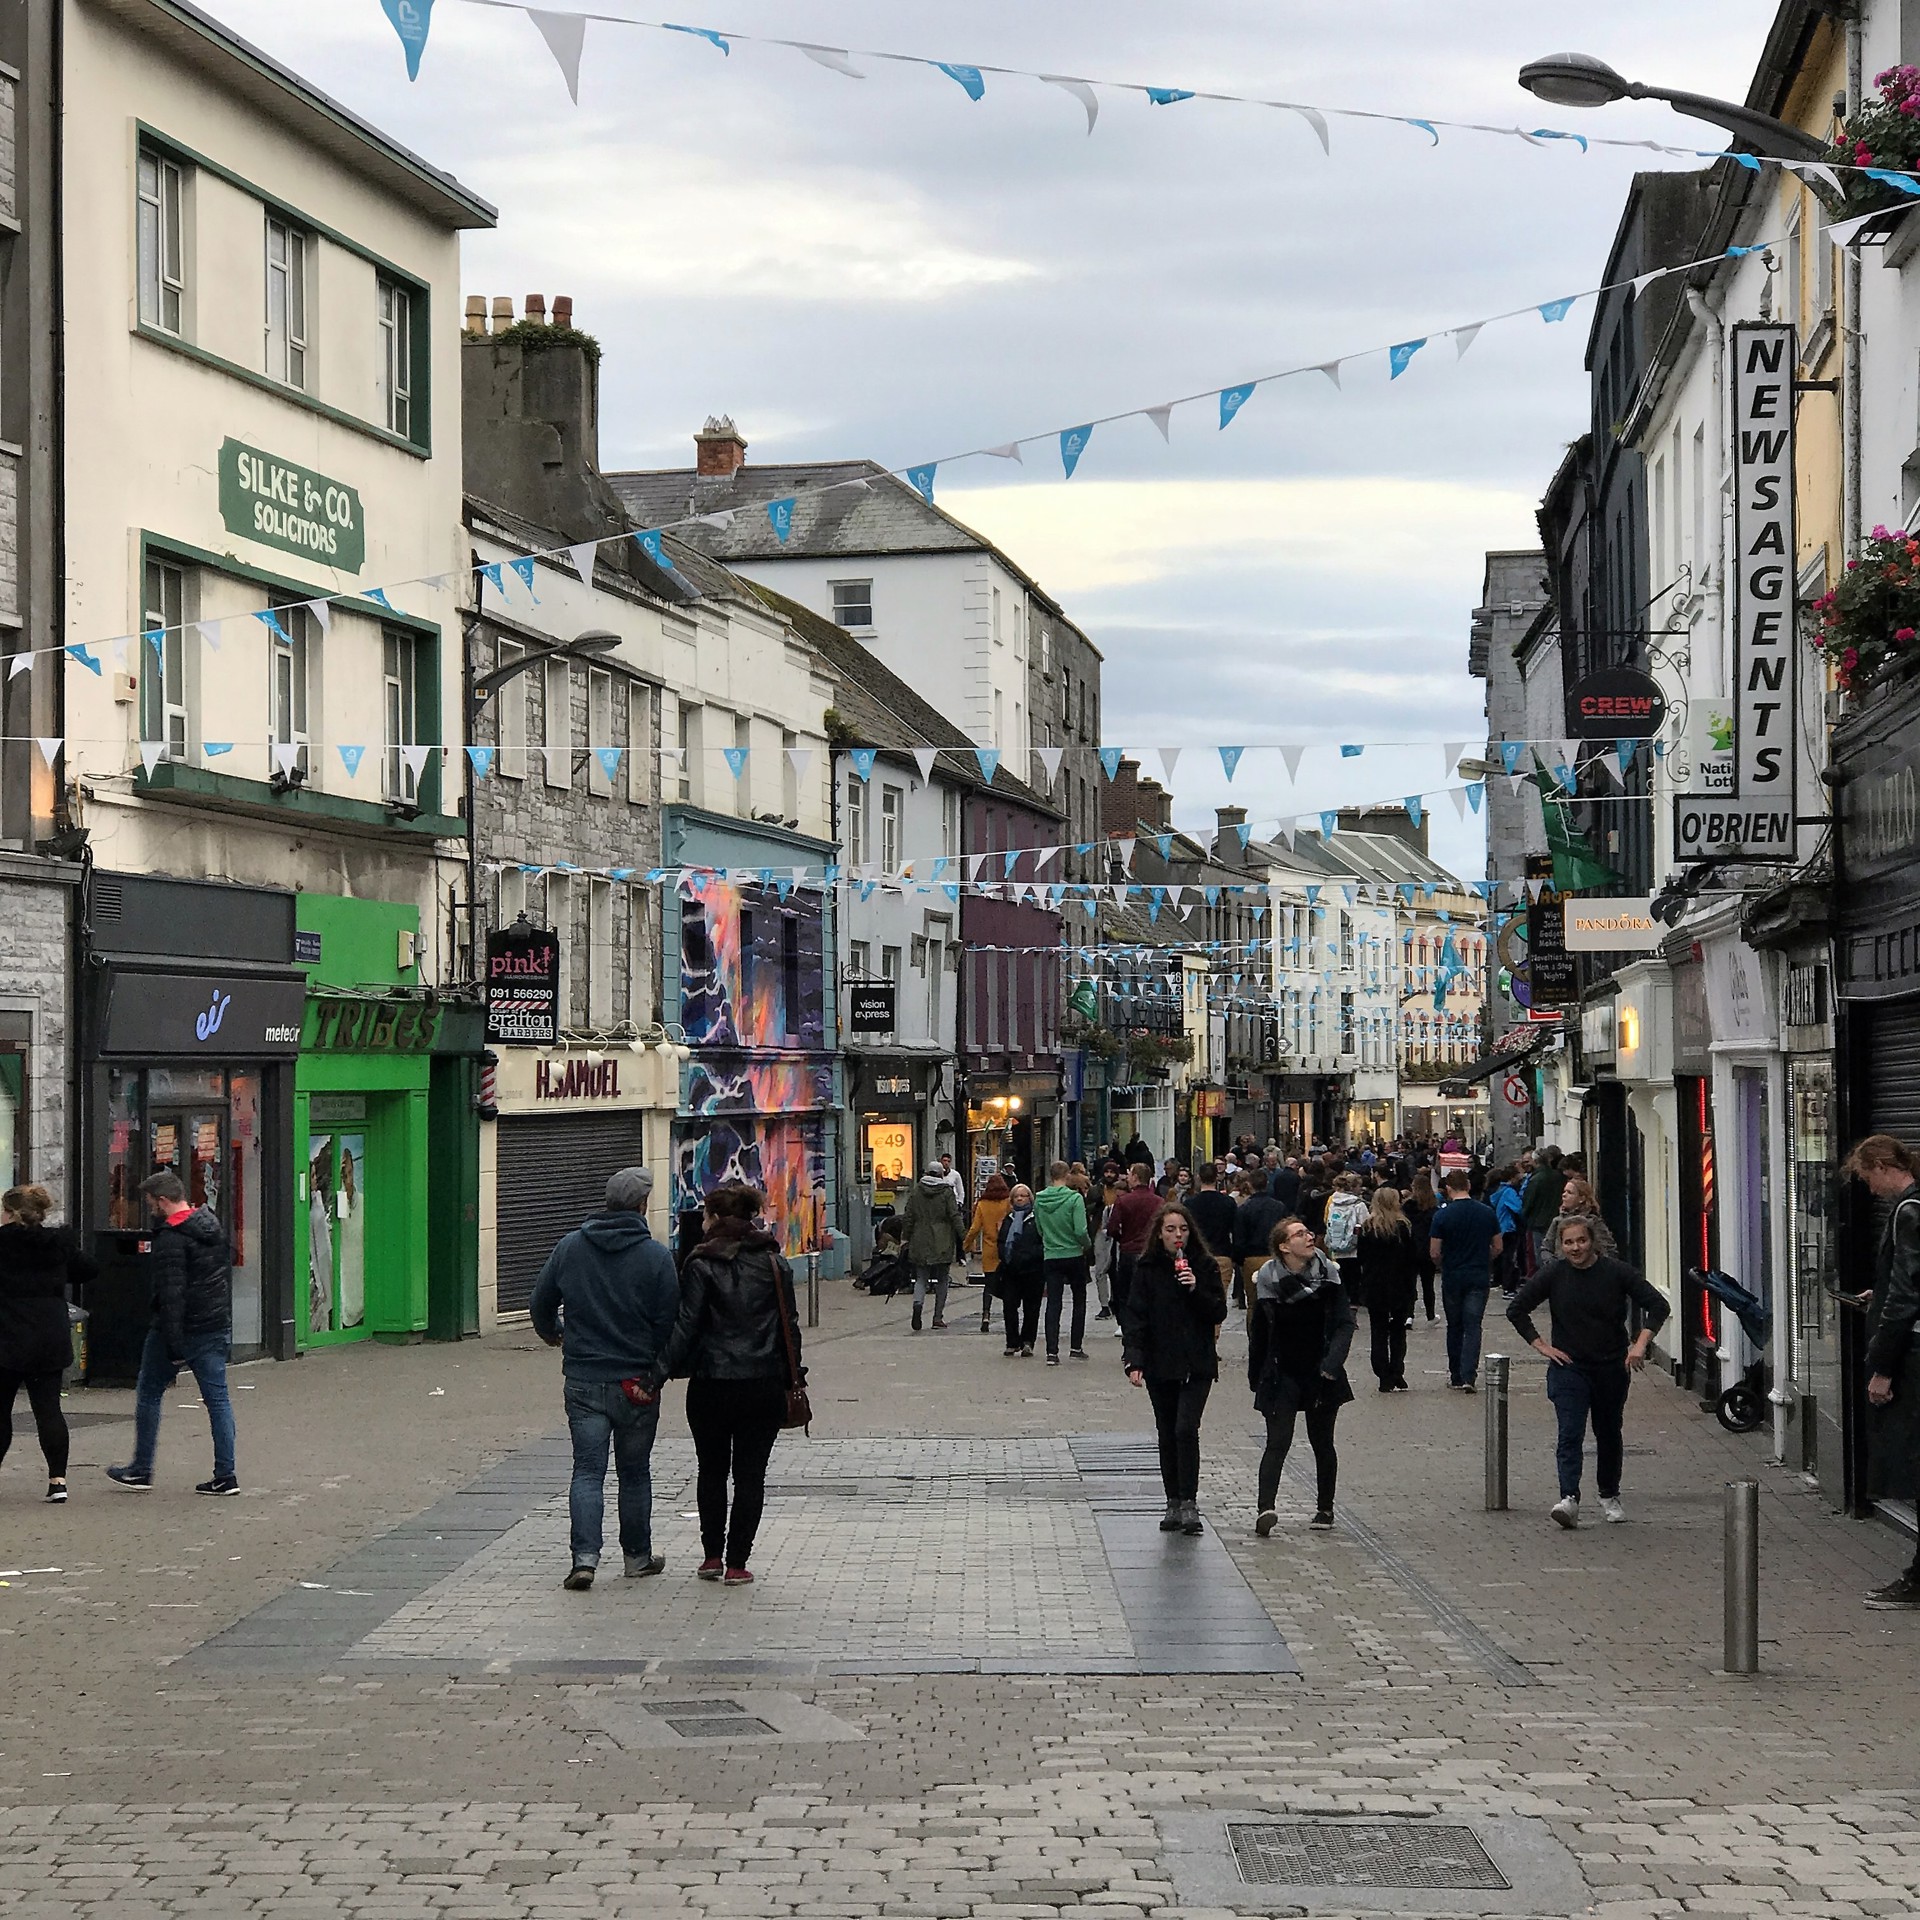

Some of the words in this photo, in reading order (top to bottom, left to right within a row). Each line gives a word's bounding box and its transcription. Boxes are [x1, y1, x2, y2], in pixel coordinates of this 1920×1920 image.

[237, 452, 298, 508] SILKE
[304, 479, 322, 512] &
[325, 486, 354, 530] CO.
[254, 501, 337, 554] SOLICITORS
[1742, 339, 1789, 783] NEWSAGENTS
[1581, 696, 1652, 714] CREW
[1700, 763, 1733, 775] Nati
[1682, 812, 1789, 843] O'BRIEN
[1576, 914, 1653, 931] PANDORA
[1539, 930, 1565, 940] Gadget
[491, 946, 551, 977] pink!
[490, 988, 509, 998] 091
[513, 989, 553, 999] 566290
[860, 1000, 885, 1008] vision
[488, 1009, 553, 1031] grafton
[855, 1010, 890, 1020] express
[265, 1023, 300, 1042] meteor
[314, 1001, 440, 1048] TRIBES
[502, 1028, 552, 1038] BARBERS
[874, 1133, 905, 1148] €49
